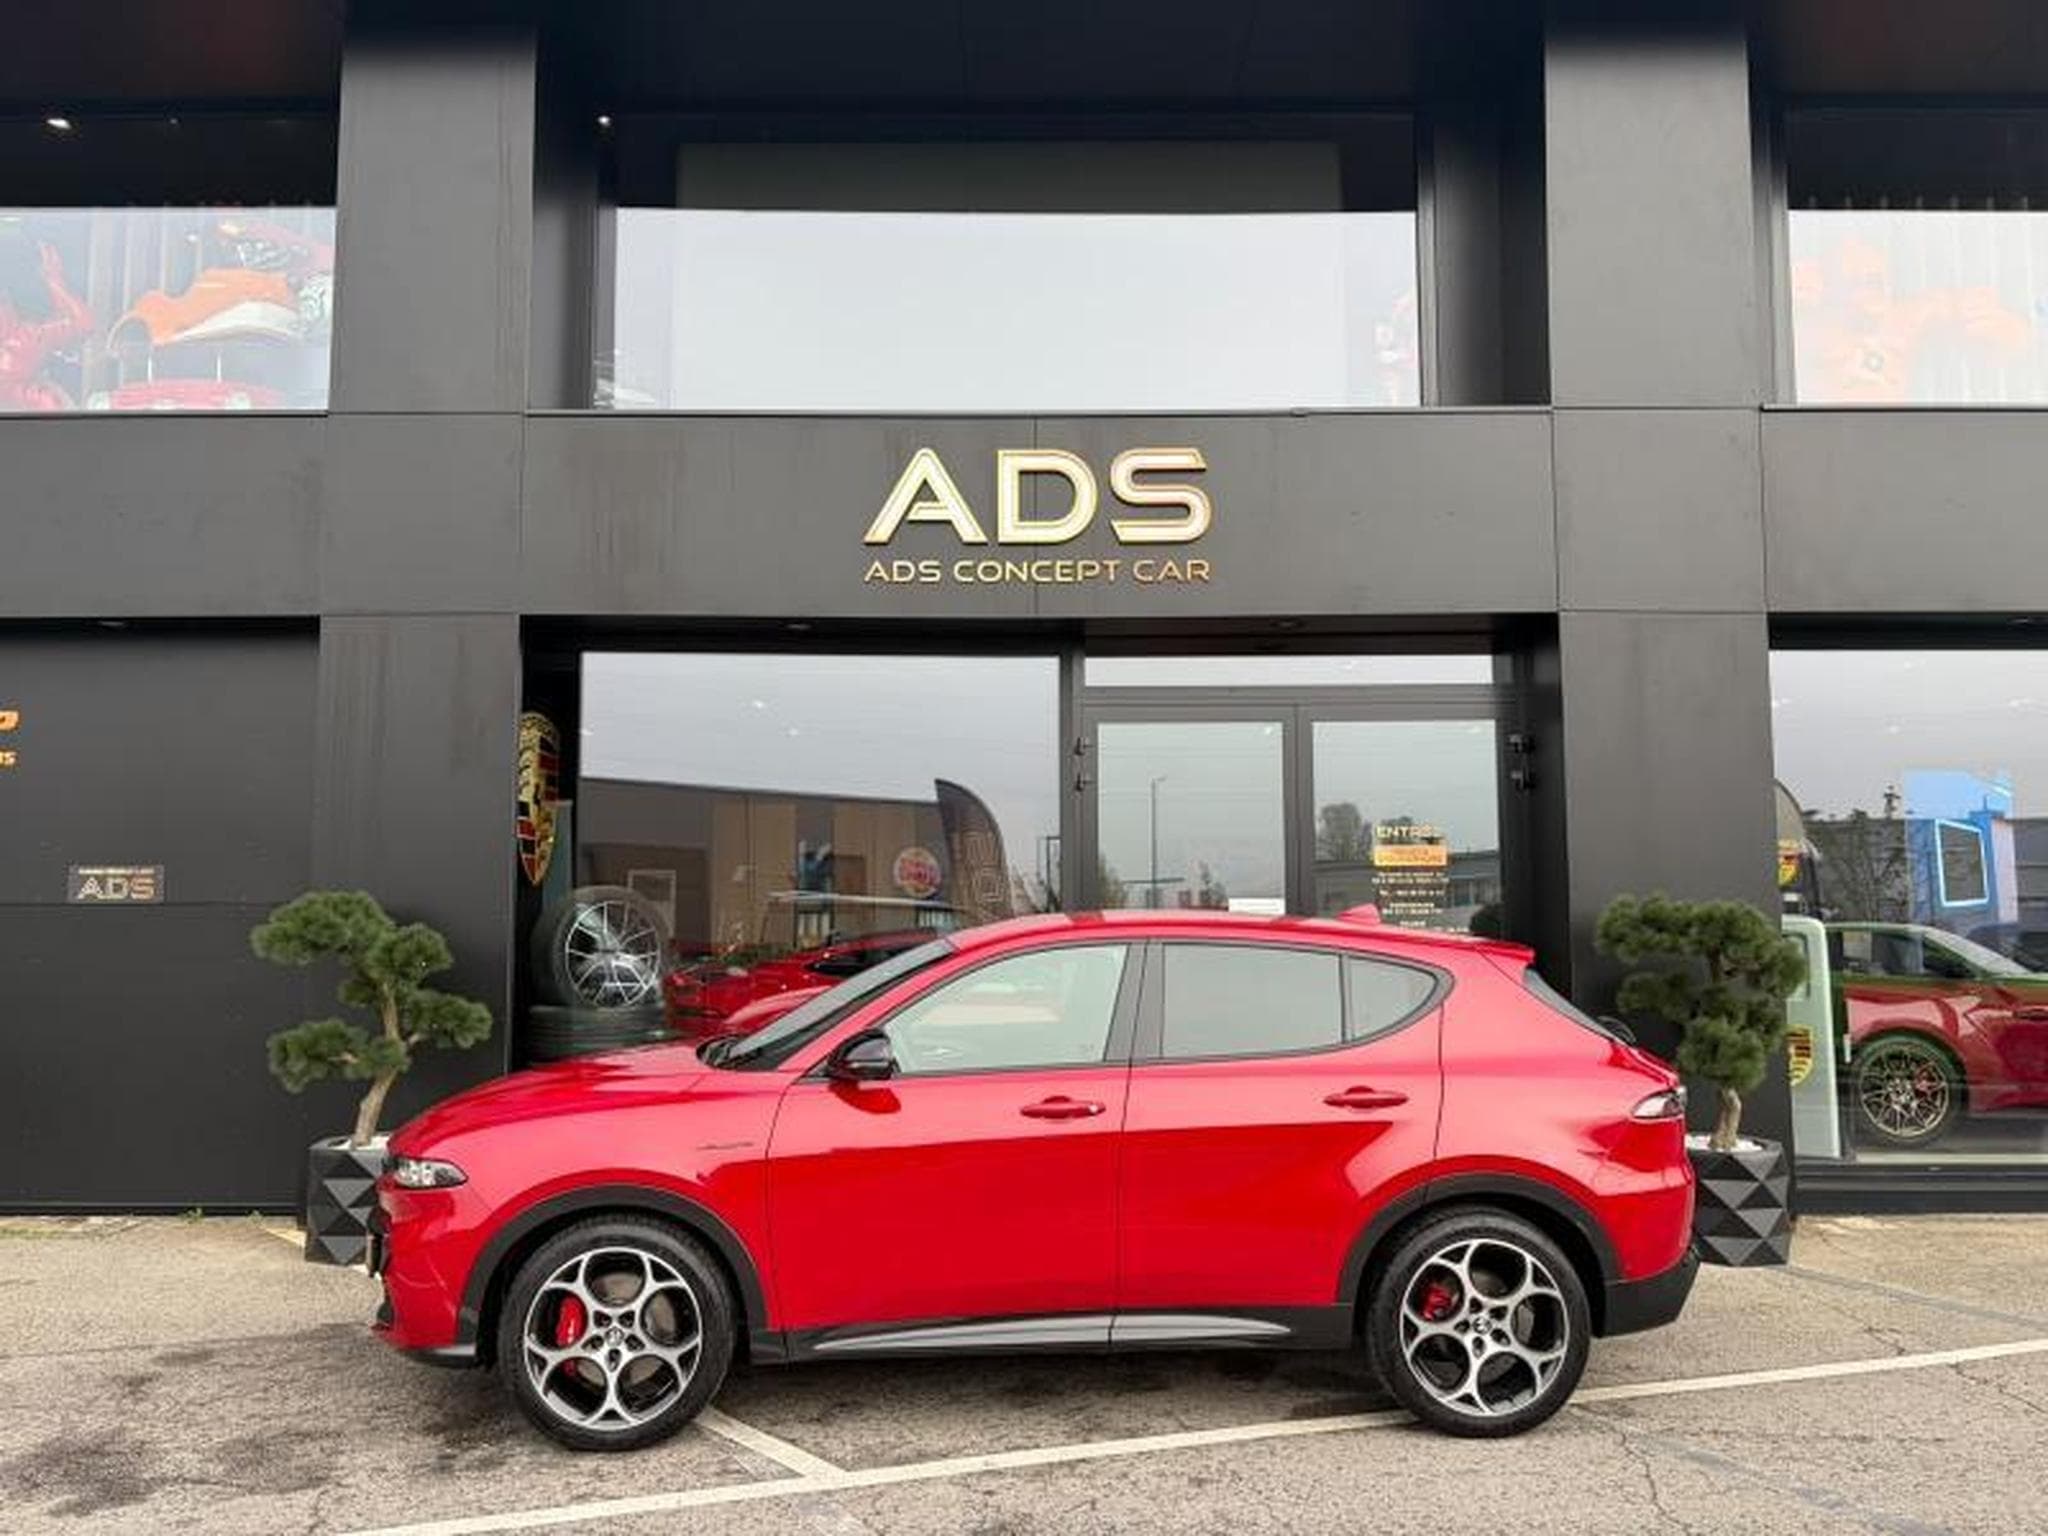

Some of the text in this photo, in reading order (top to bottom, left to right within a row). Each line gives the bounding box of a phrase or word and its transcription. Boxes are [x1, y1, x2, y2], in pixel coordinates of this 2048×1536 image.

[863, 447, 1212, 545] ADS
[864, 559, 1212, 583] ADS CONCEPT CAR
[78, 876, 155, 900] ADS
